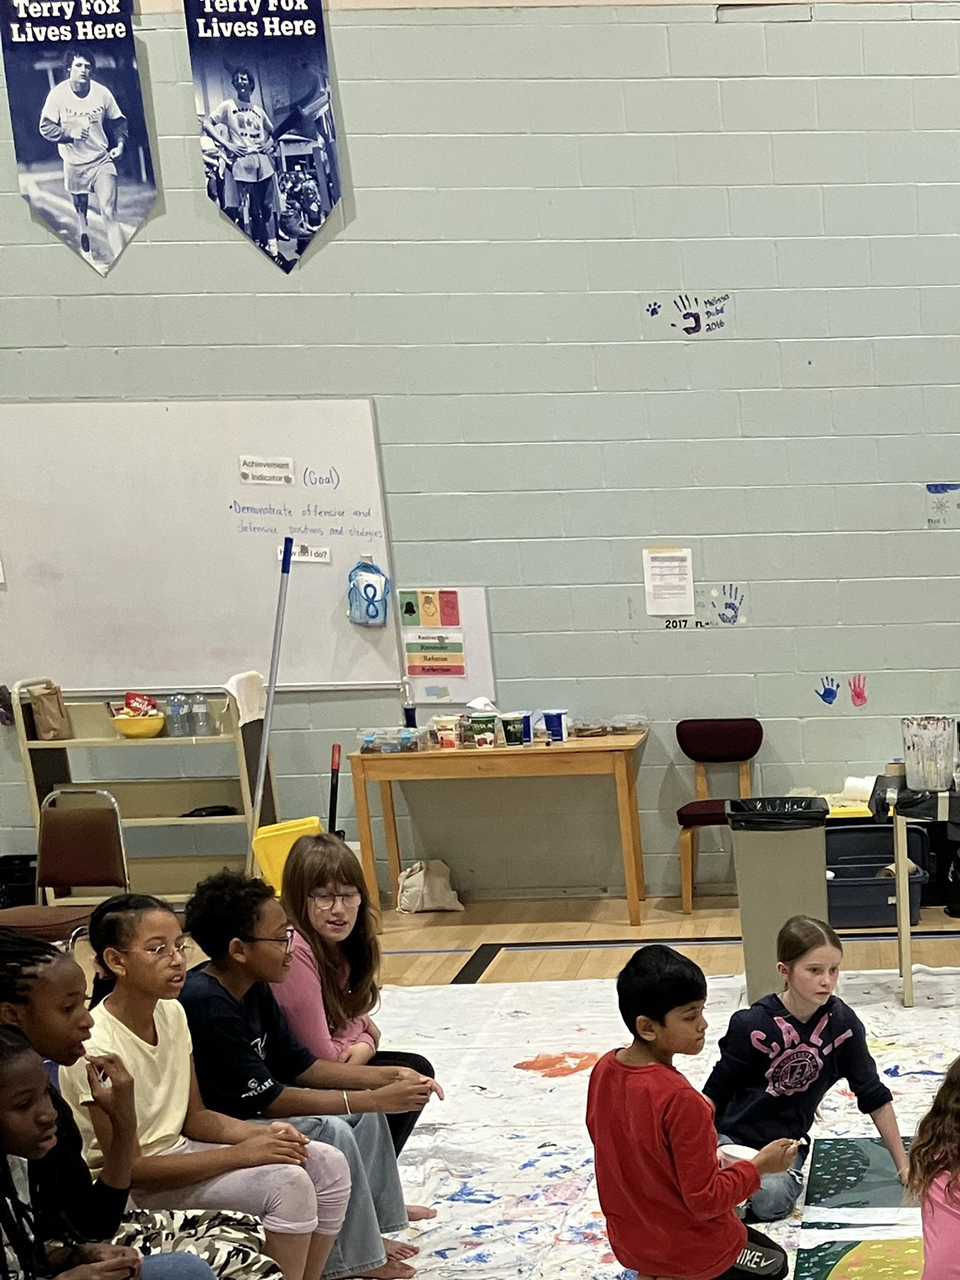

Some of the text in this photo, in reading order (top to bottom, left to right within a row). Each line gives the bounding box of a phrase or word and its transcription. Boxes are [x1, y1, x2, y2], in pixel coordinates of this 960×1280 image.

[13, 0, 121, 20] Terry Fox
[202, 0, 308, 16] Terry Fox
[10, 20, 127, 42] Lives Here
[196, 16, 317, 38] Lives Here
[705, 319, 725, 332] 2016
[242, 459, 290, 470] Achievement
[251, 473, 284, 482] Indicator
[303, 465, 340, 490] (Goal)
[233, 500, 371, 517] Demonstrate offensive and
[330, 526, 344, 536] and
[314, 550, 328, 559] do?
[665, 619, 688, 629] 2017
